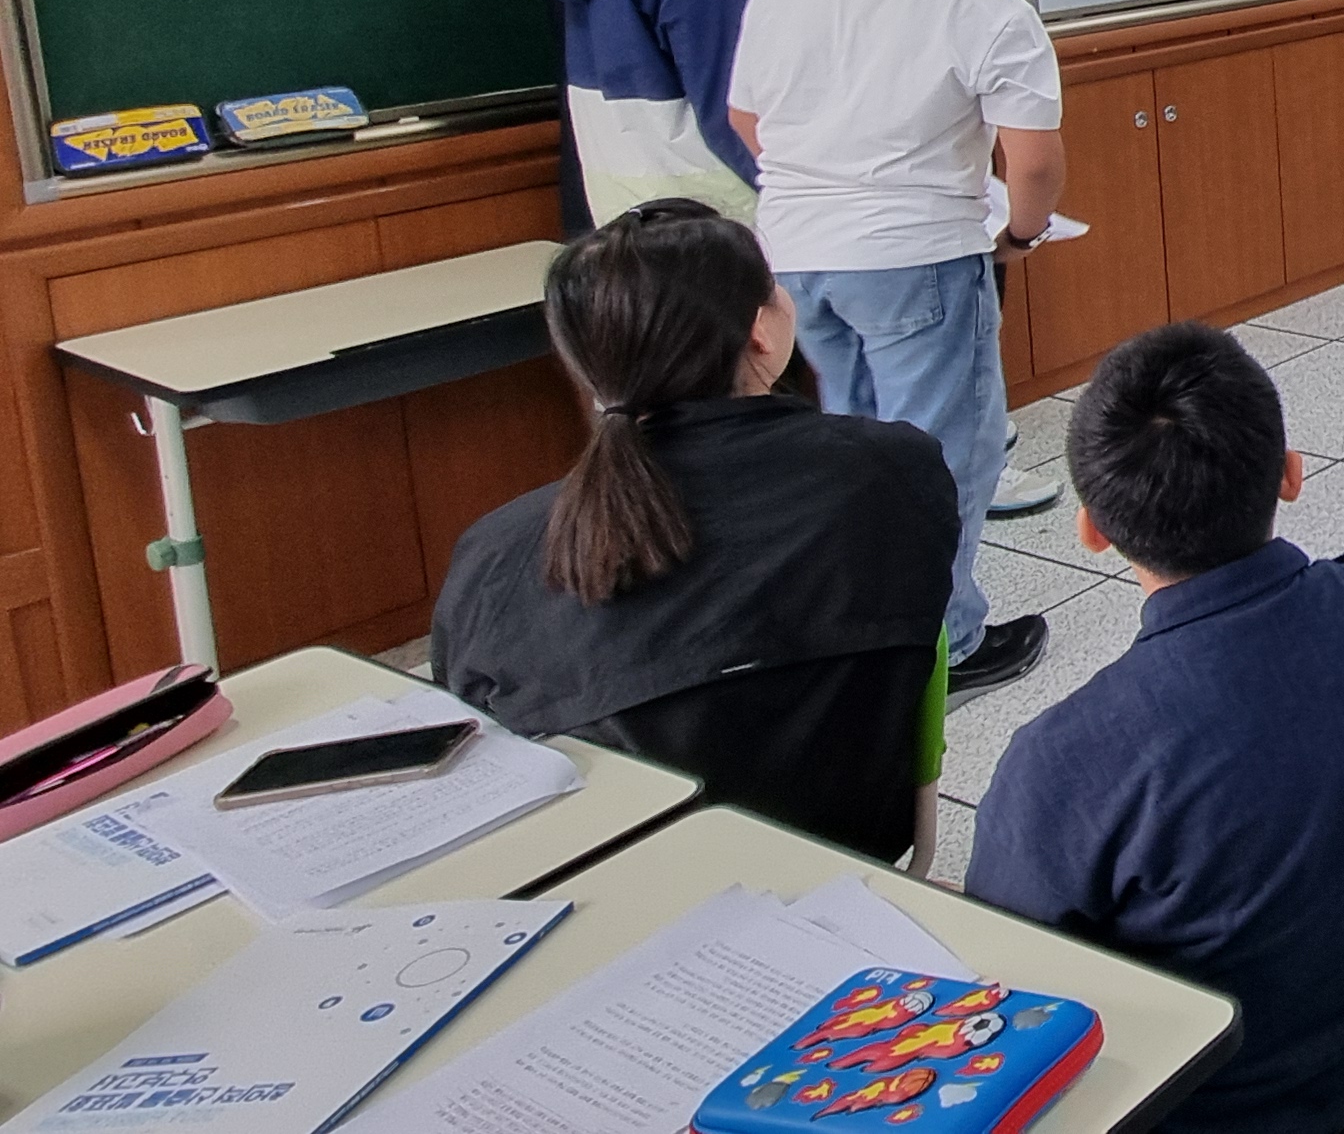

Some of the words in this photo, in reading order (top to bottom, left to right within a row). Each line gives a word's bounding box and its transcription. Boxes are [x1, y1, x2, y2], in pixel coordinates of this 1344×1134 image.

[246, 105, 289, 122] BOARD
[292, 101, 341, 116] ERASER
[83, 132, 137, 151] ERASER
[141, 125, 188, 144] BOARD
[87, 1066, 219, 1092] 연구보고서
